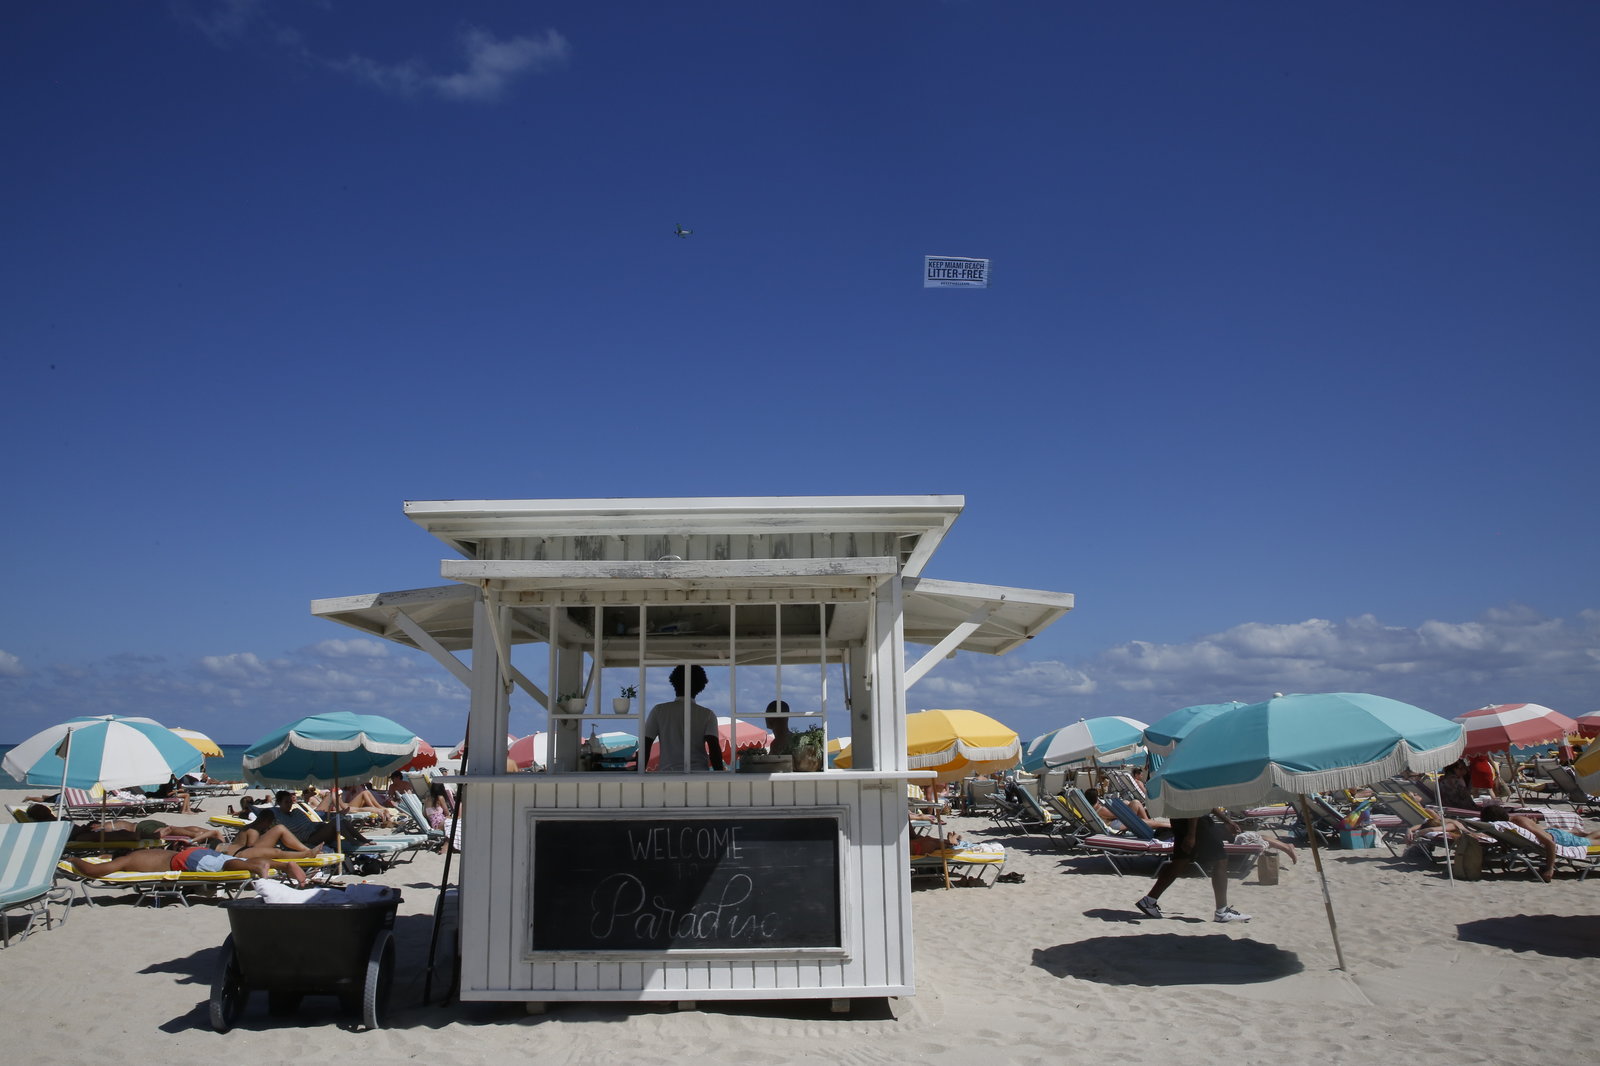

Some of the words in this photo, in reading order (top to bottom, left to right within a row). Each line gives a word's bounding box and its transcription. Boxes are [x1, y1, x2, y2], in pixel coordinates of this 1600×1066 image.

[928, 261, 944, 269] KEEP
[928, 268, 984, 278] LITTER-FREE
[627, 826, 745, 861] WELCOME
